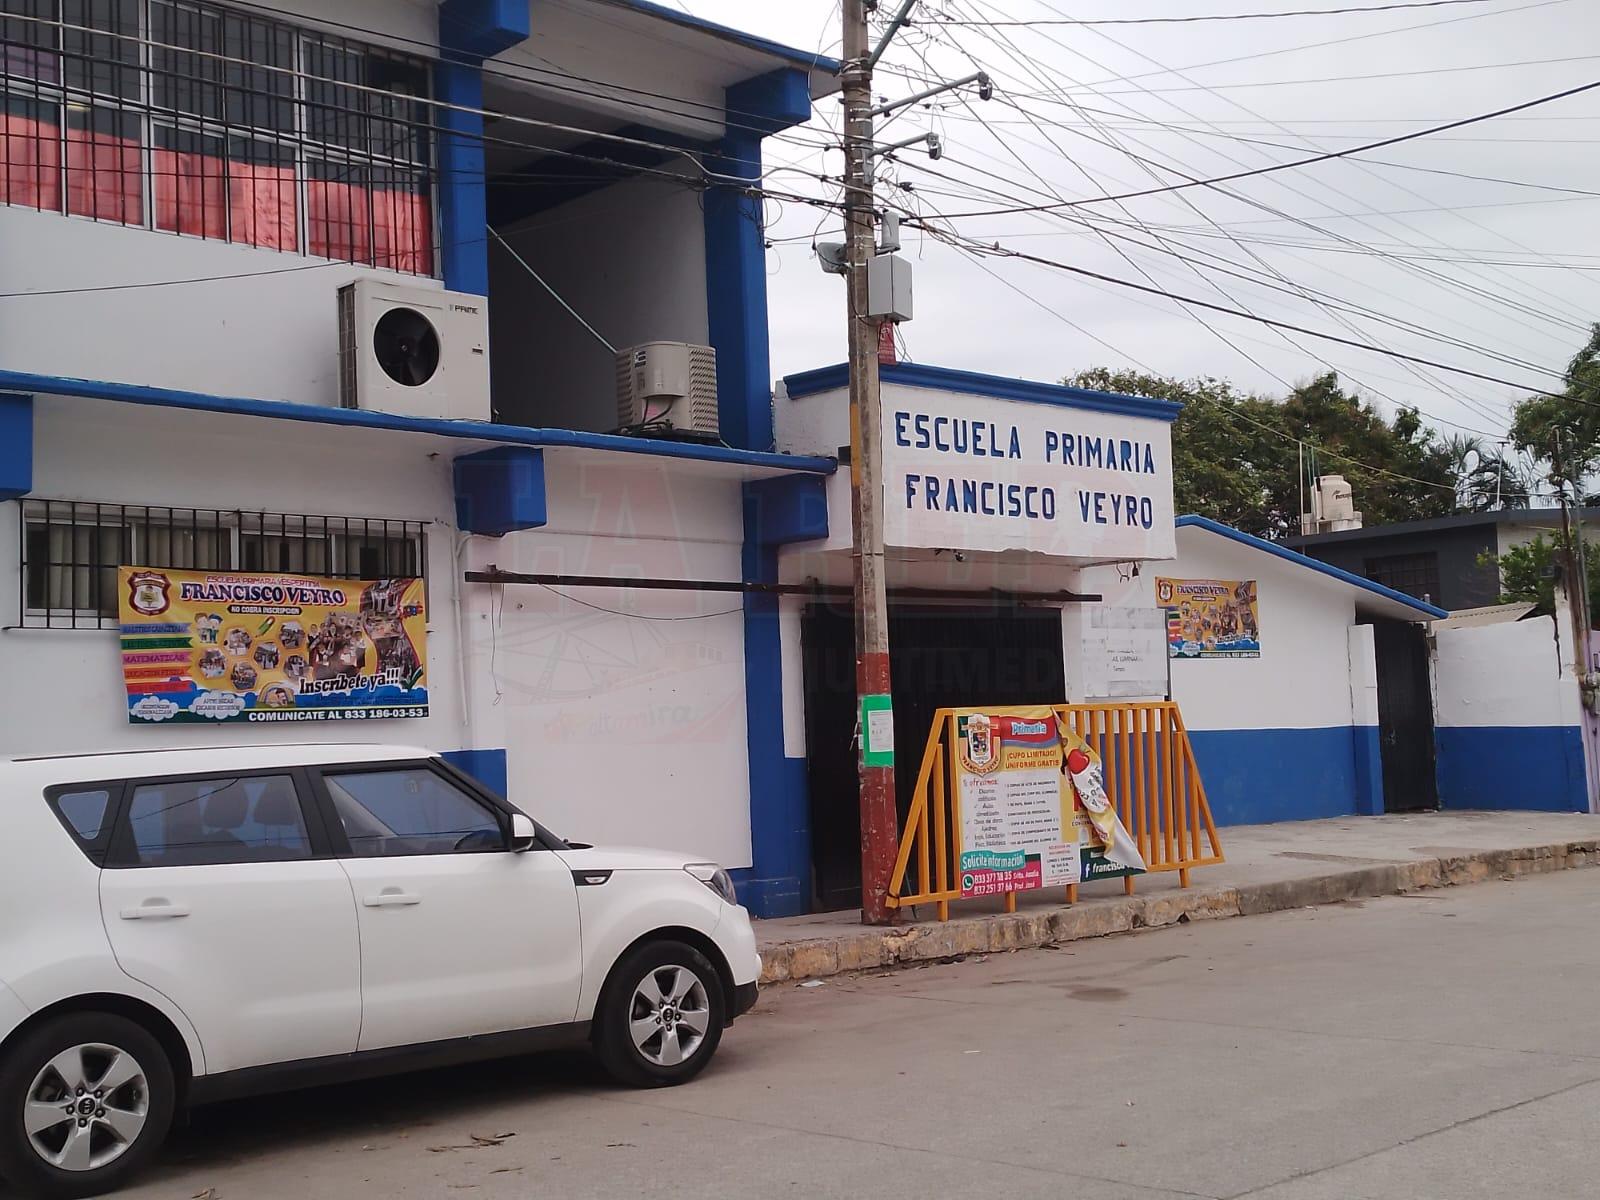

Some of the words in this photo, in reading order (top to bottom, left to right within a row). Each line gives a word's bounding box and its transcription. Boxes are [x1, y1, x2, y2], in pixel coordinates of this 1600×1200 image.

[895, 412, 1021, 459] ESCUELA
[1045, 431, 1155, 474] PRIMARIA
[905, 474, 1056, 520] FRANCISCO
[1078, 490, 1153, 529] VEYRO
[206, 575, 240, 585] ESCUELA
[181, 582, 285, 603] FRANCISCO
[286, 587, 347, 606] VEYRO
[249, 711, 326, 722] COMUNICATE
[327, 711, 343, 720] AL
[344, 710, 366, 719] 833
[369, 708, 424, 718] 186-03-53
[1005, 760, 1037, 769] UNIFORME
[1037, 759, 1060, 768] GRATIS
